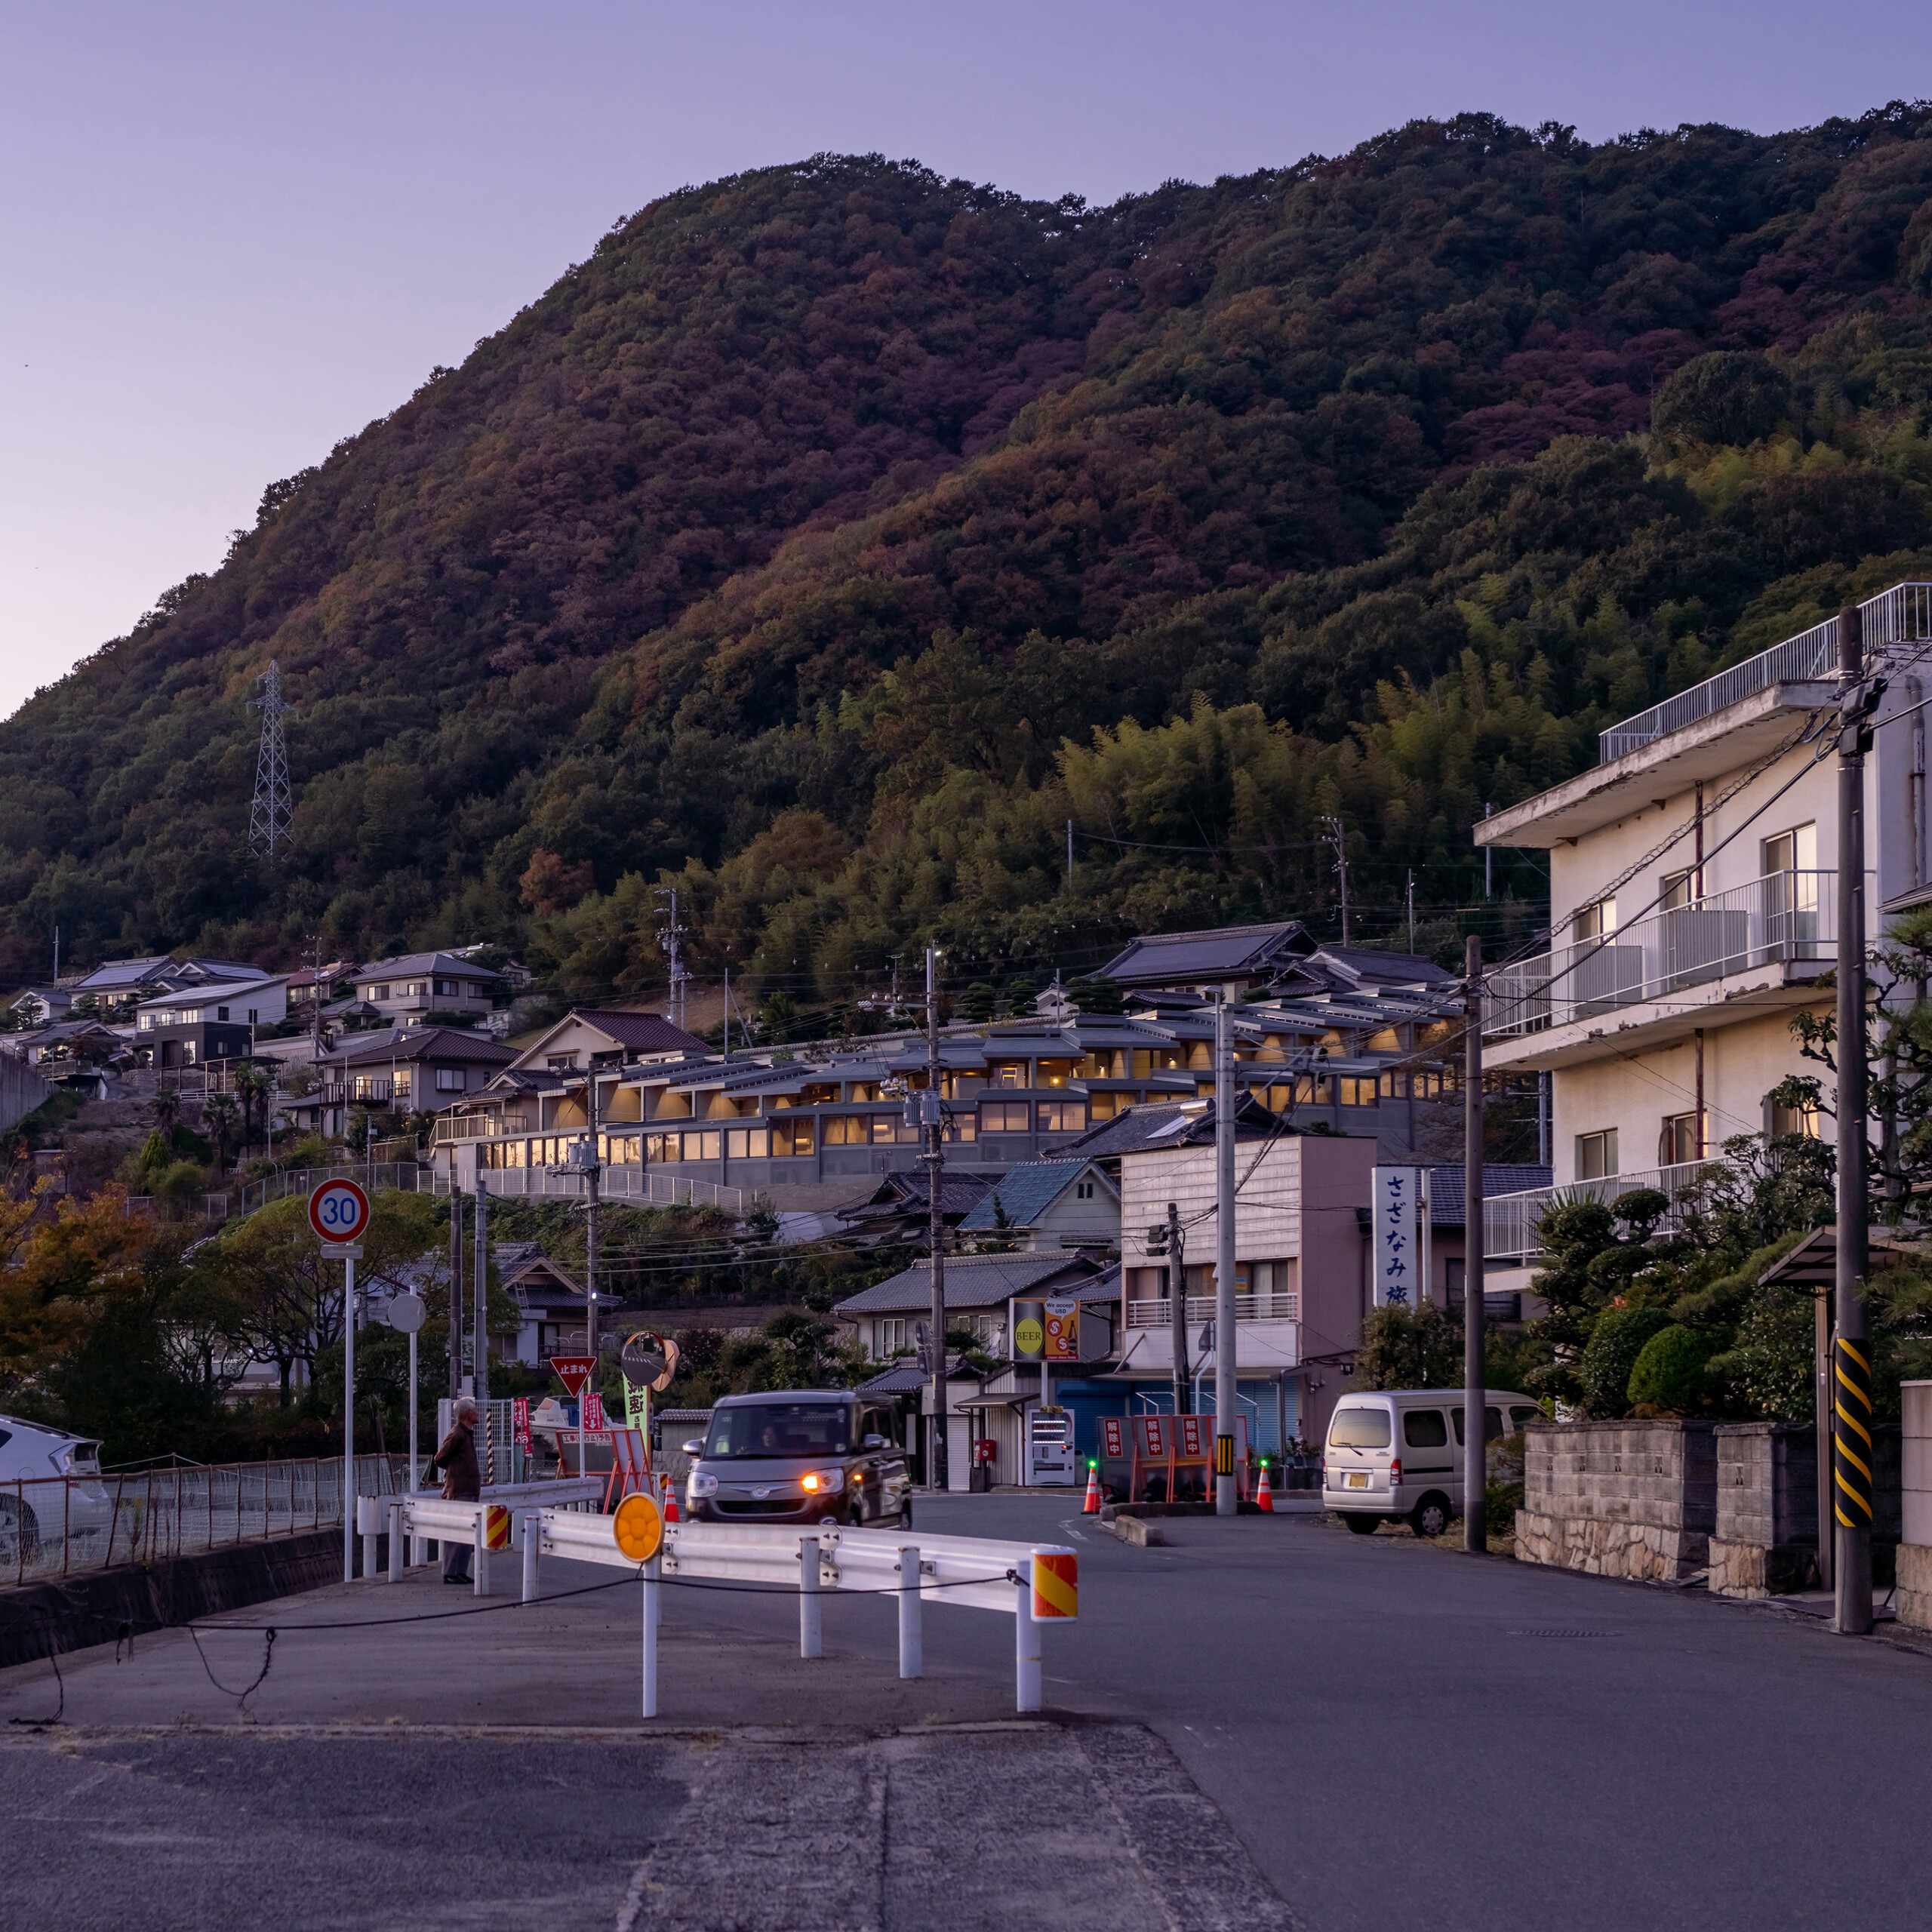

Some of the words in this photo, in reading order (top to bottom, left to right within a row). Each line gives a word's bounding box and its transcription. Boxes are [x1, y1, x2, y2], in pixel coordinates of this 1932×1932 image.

[323, 1197, 355, 1225] 30
[1386, 1176, 1407, 1304] さざなみ旅
[1016, 1332, 1041, 1340] BEER
[560, 1364, 588, 1374] 止まれ
[563, 1434, 611, 1442] 工事(行止)予告
[1107, 1422, 1120, 1454] 解除中
[1147, 1420, 1161, 1453] 解除中
[1186, 1420, 1198, 1452] 解除中
